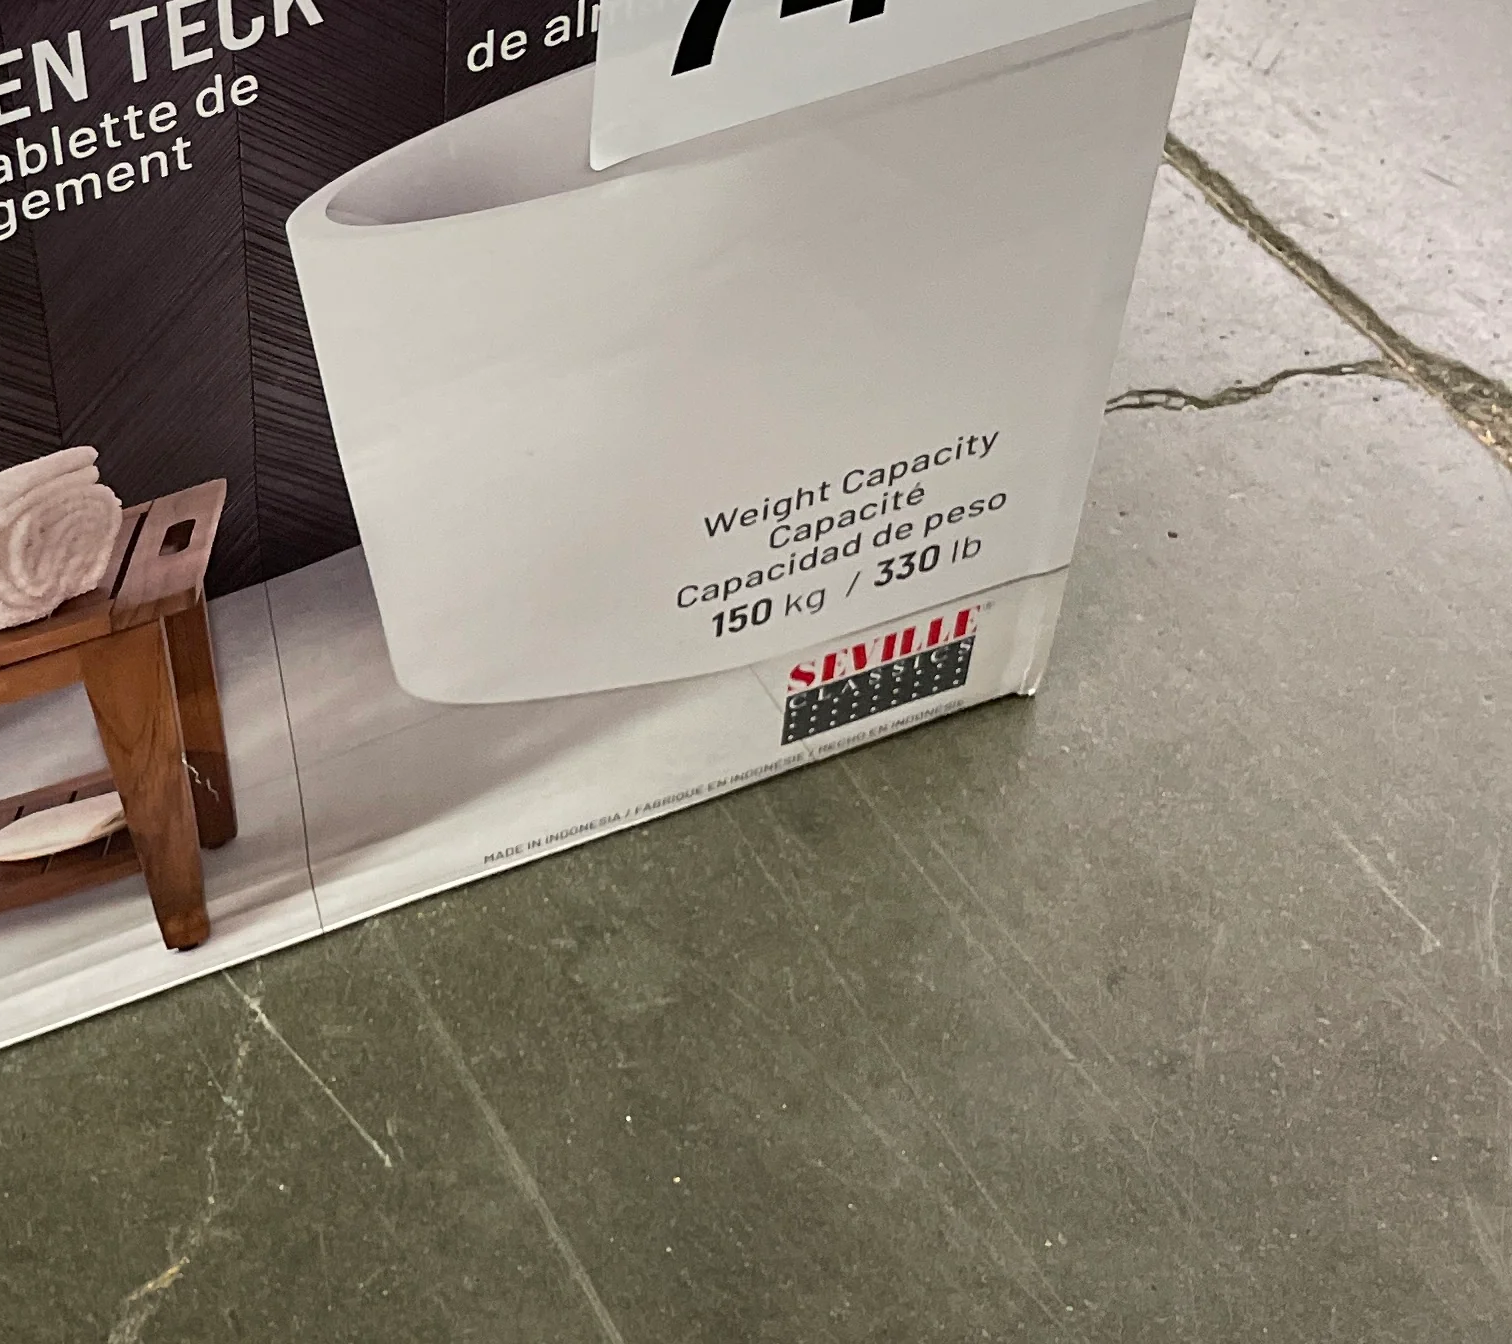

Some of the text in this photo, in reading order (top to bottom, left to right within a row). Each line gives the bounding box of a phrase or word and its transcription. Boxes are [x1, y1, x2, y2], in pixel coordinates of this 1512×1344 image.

[466, 26, 527, 74] de
[195, 74, 259, 118] de
[704, 431, 1000, 538] Weight Capacity
[769, 481, 925, 548] Capacité
[677, 492, 1007, 609] Capacidad de peso
[711, 536, 982, 638] 150 kg / 330 lb
[787, 605, 981, 692] SEVILLE
[788, 638, 973, 709] CLASSICS
[484, 842, 523, 864] MADE
[527, 838, 541, 850] IN
[545, 811, 621, 844] INDONESIA
[707, 778, 727, 792] EN
